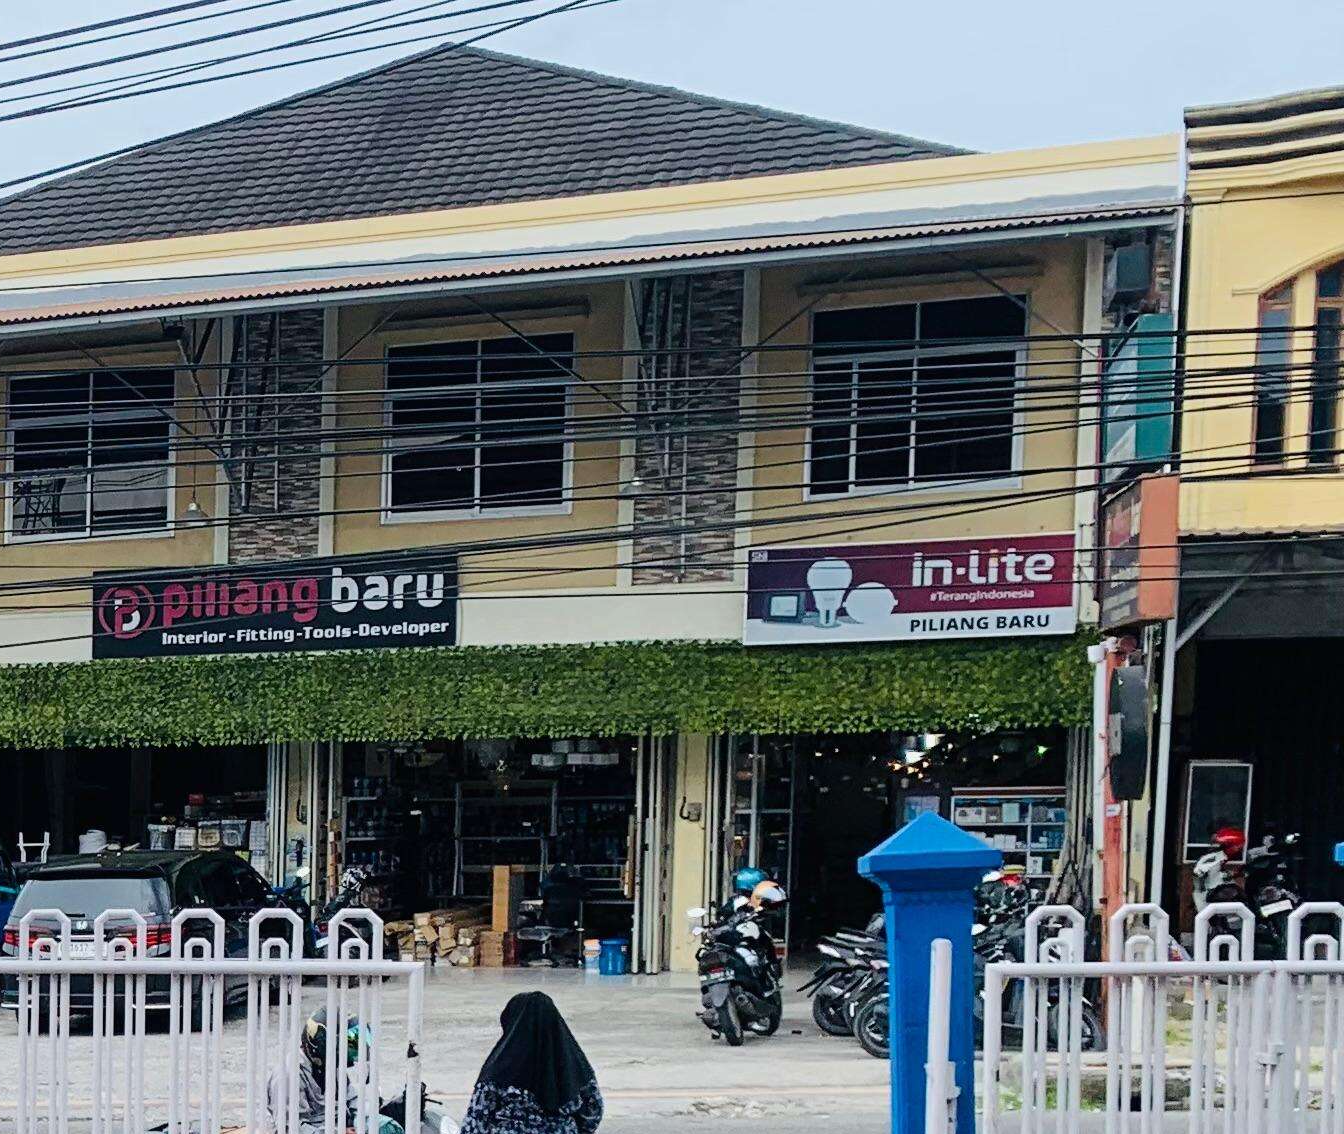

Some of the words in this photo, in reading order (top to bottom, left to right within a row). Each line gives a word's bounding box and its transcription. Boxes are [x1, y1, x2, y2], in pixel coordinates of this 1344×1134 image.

[163, 574, 319, 629] piliang
[331, 567, 444, 613] baru
[929, 589, 1035, 603] #TerangIndonesia
[910, 616, 989, 632] PILIANG
[996, 614, 1050, 629] BARU
